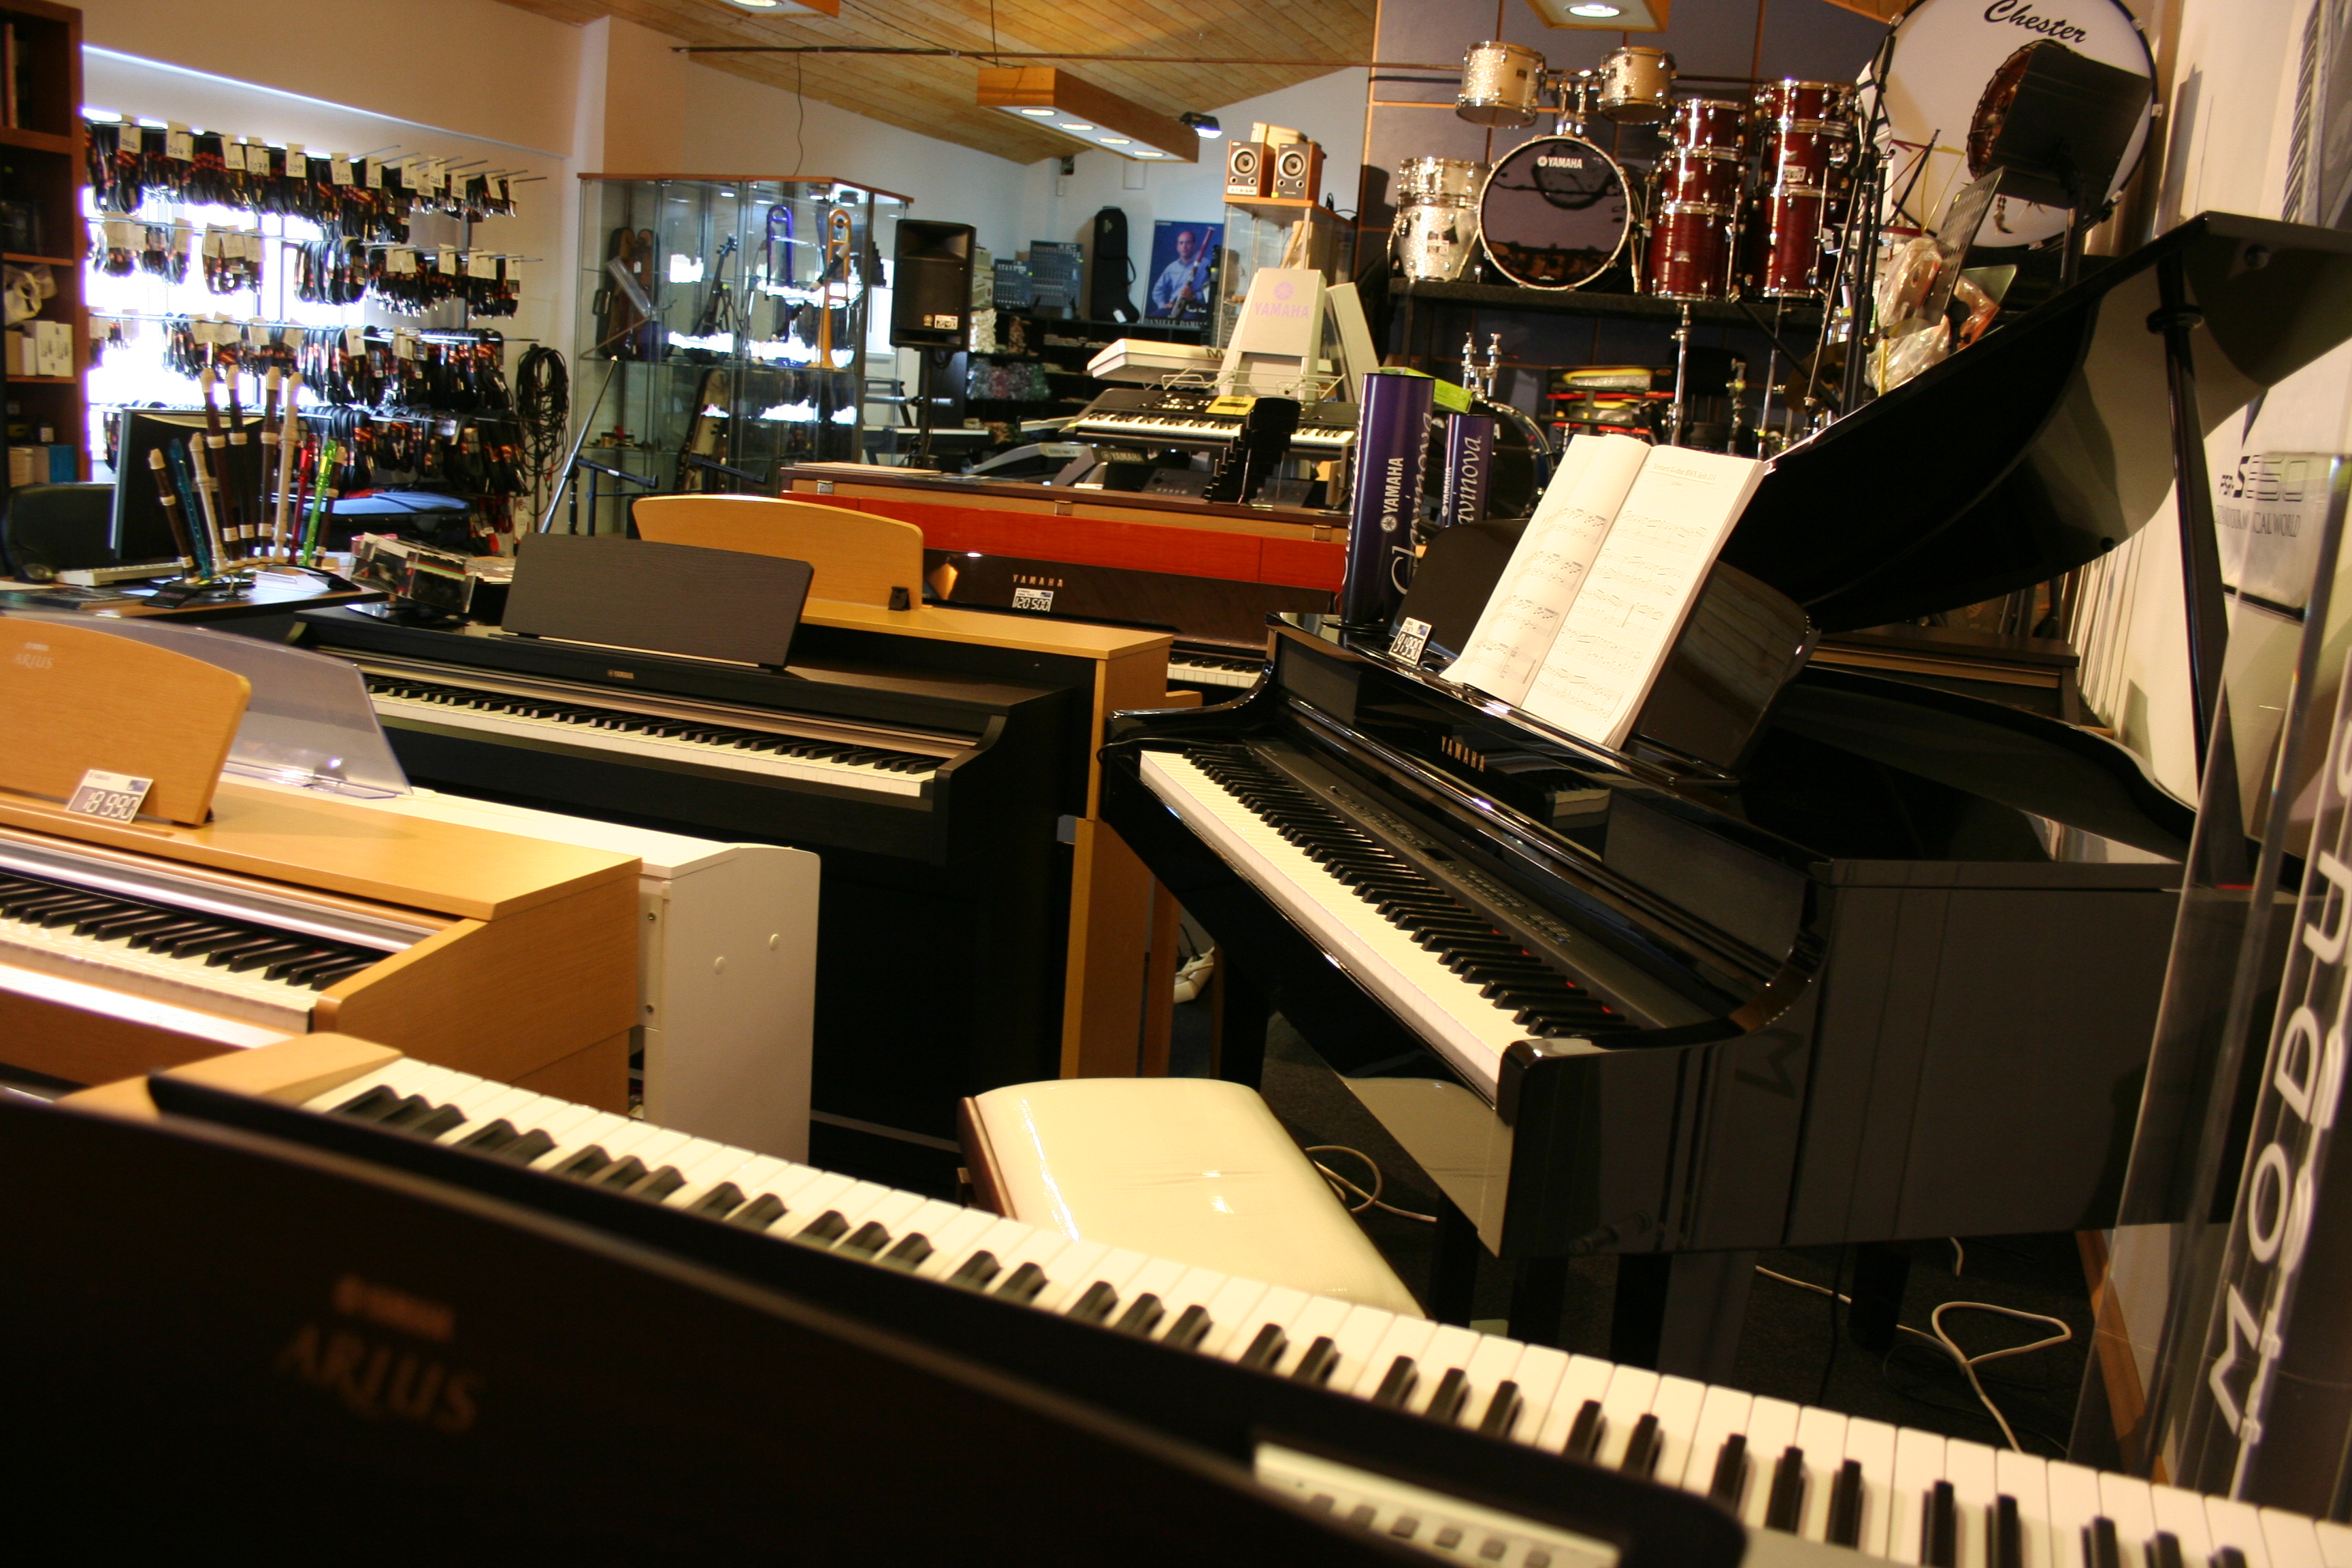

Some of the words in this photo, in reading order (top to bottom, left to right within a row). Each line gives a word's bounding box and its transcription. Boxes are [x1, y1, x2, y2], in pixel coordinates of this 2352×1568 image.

[1984, 0, 2086, 43] Chester
[1548, 156, 1583, 169] YAMAHA
[1255, 302, 1310, 318] YAMAHA
[1383, 457, 1404, 514] YAMAHA
[1452, 436, 1482, 525] avinova
[1013, 574, 1063, 587] YAMAHA
[1441, 736, 1485, 772] YAMAHA
[274, 1322, 480, 1433] ARIUS
